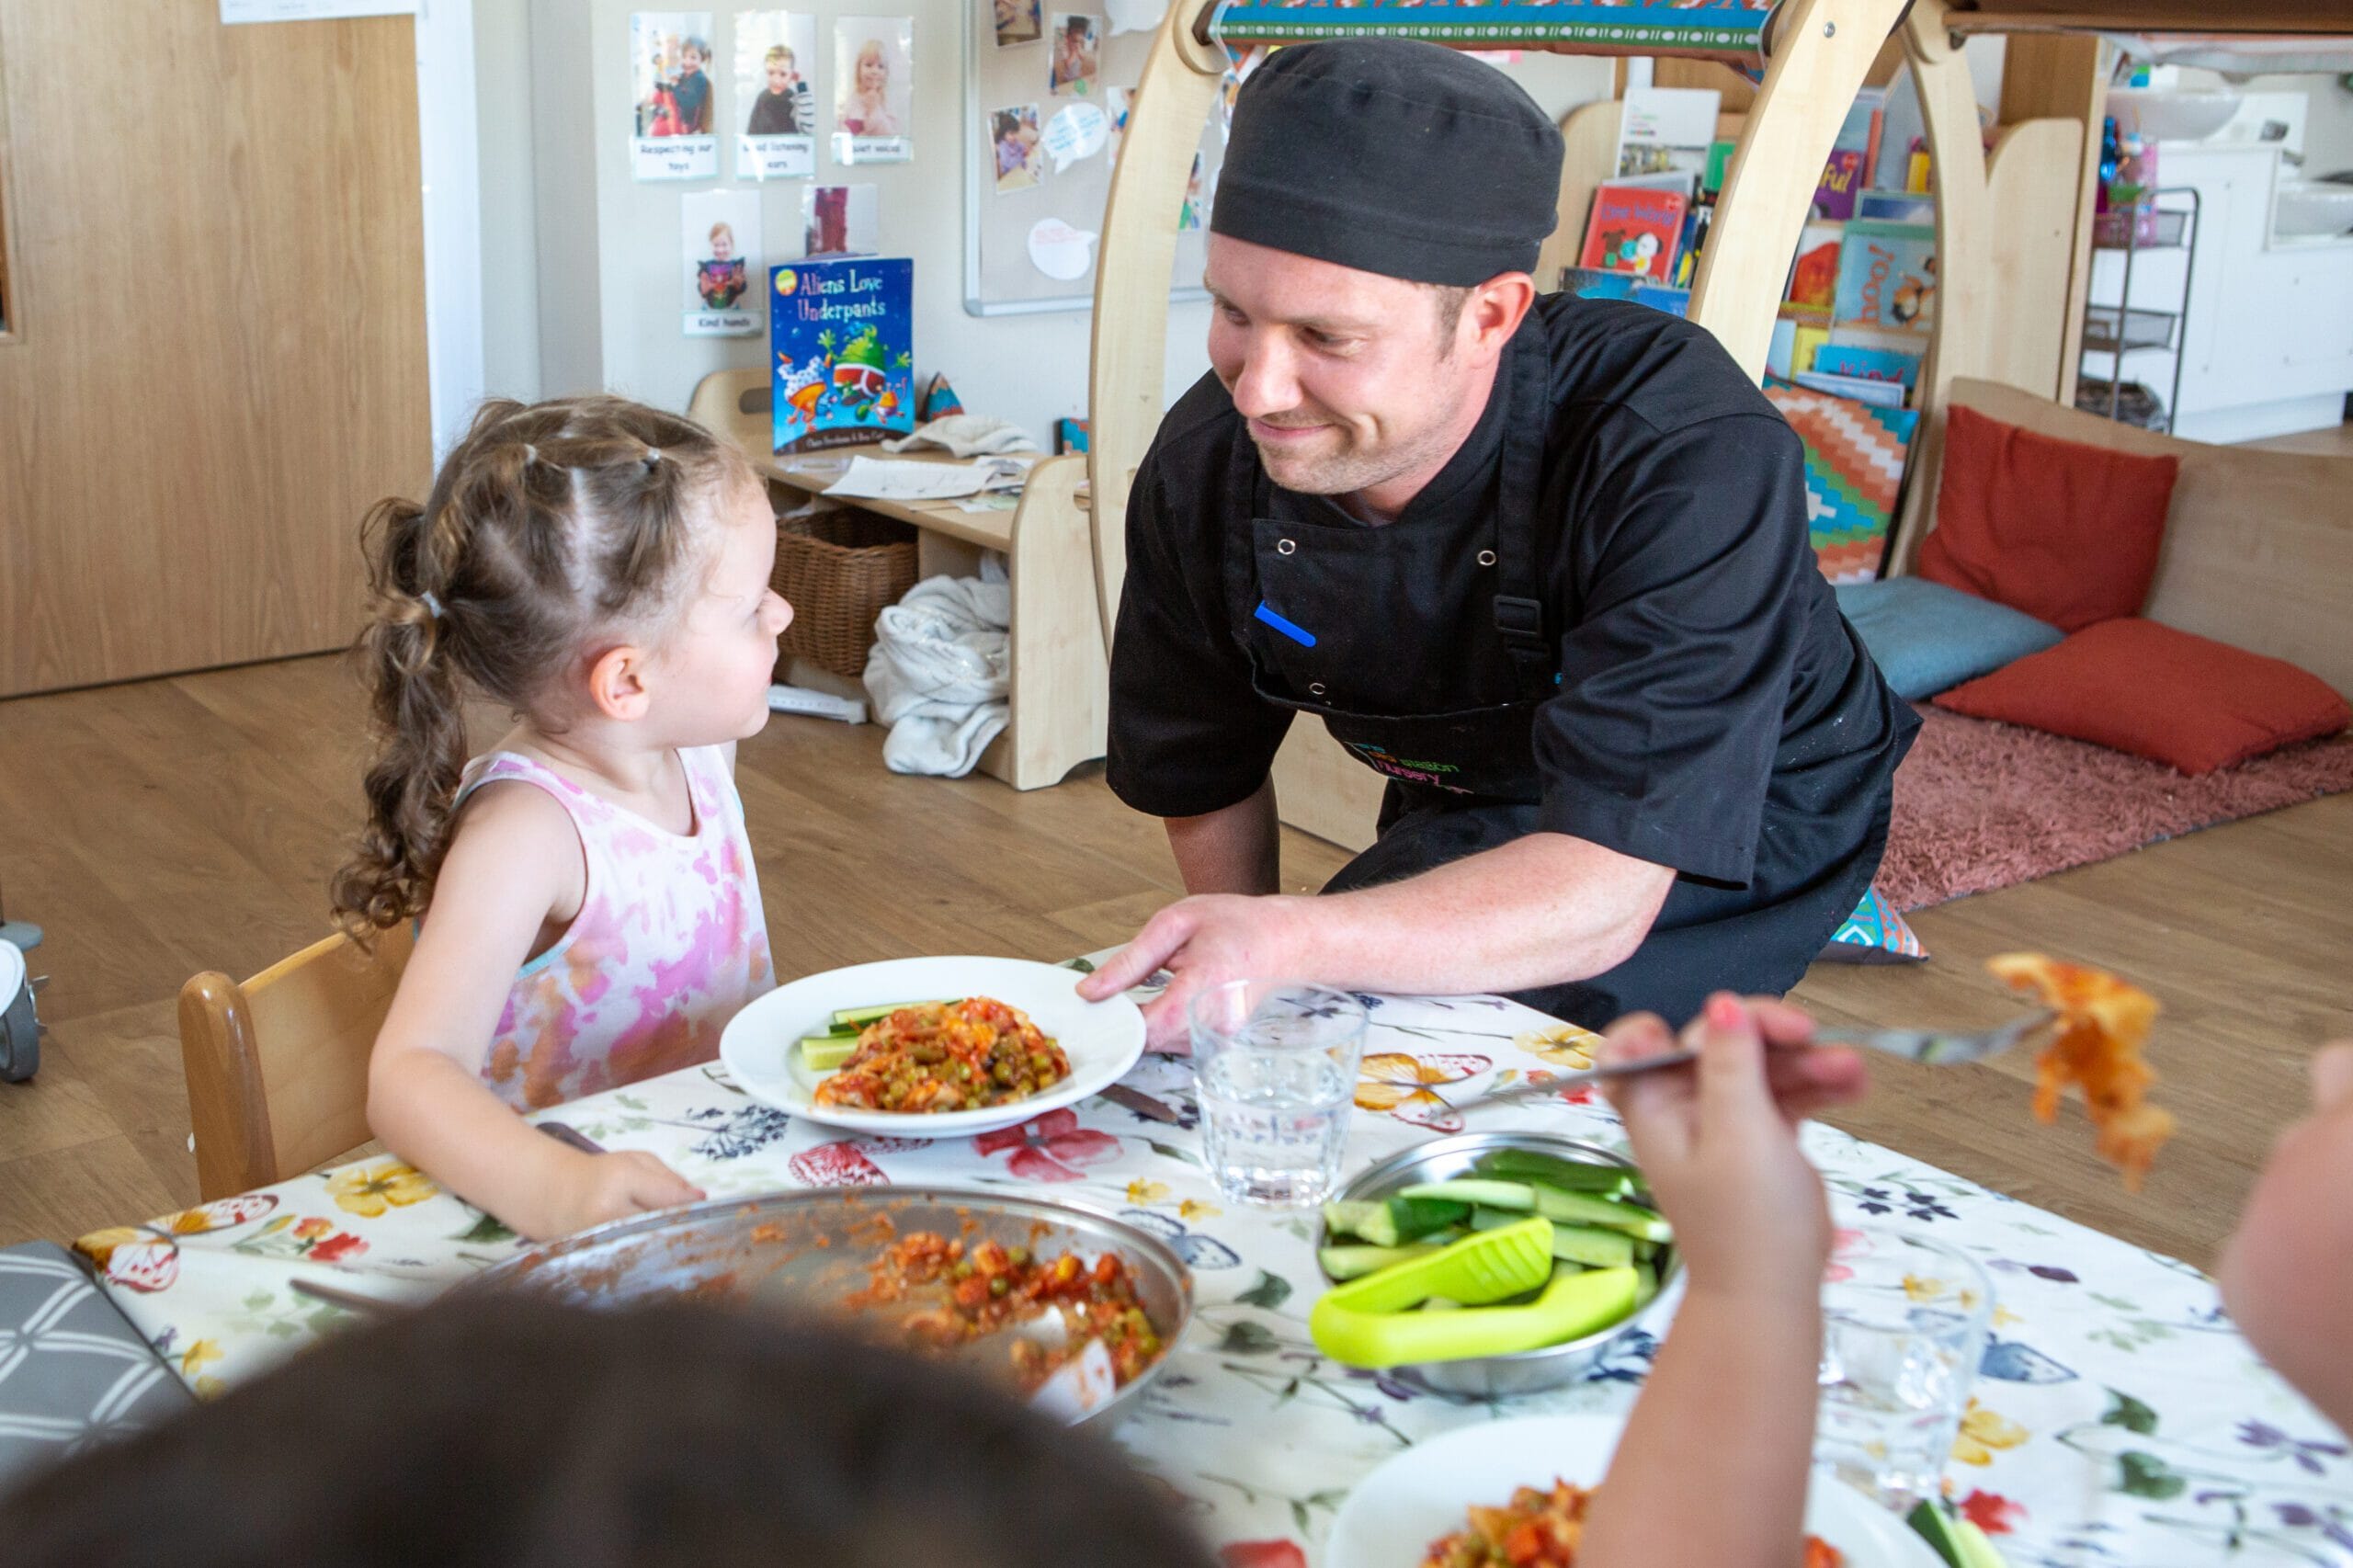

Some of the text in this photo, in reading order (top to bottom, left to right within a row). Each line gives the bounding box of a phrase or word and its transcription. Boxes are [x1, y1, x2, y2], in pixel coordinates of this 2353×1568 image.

[800, 268, 883, 296] Aliens Love
[797, 294, 886, 324] Underpants
